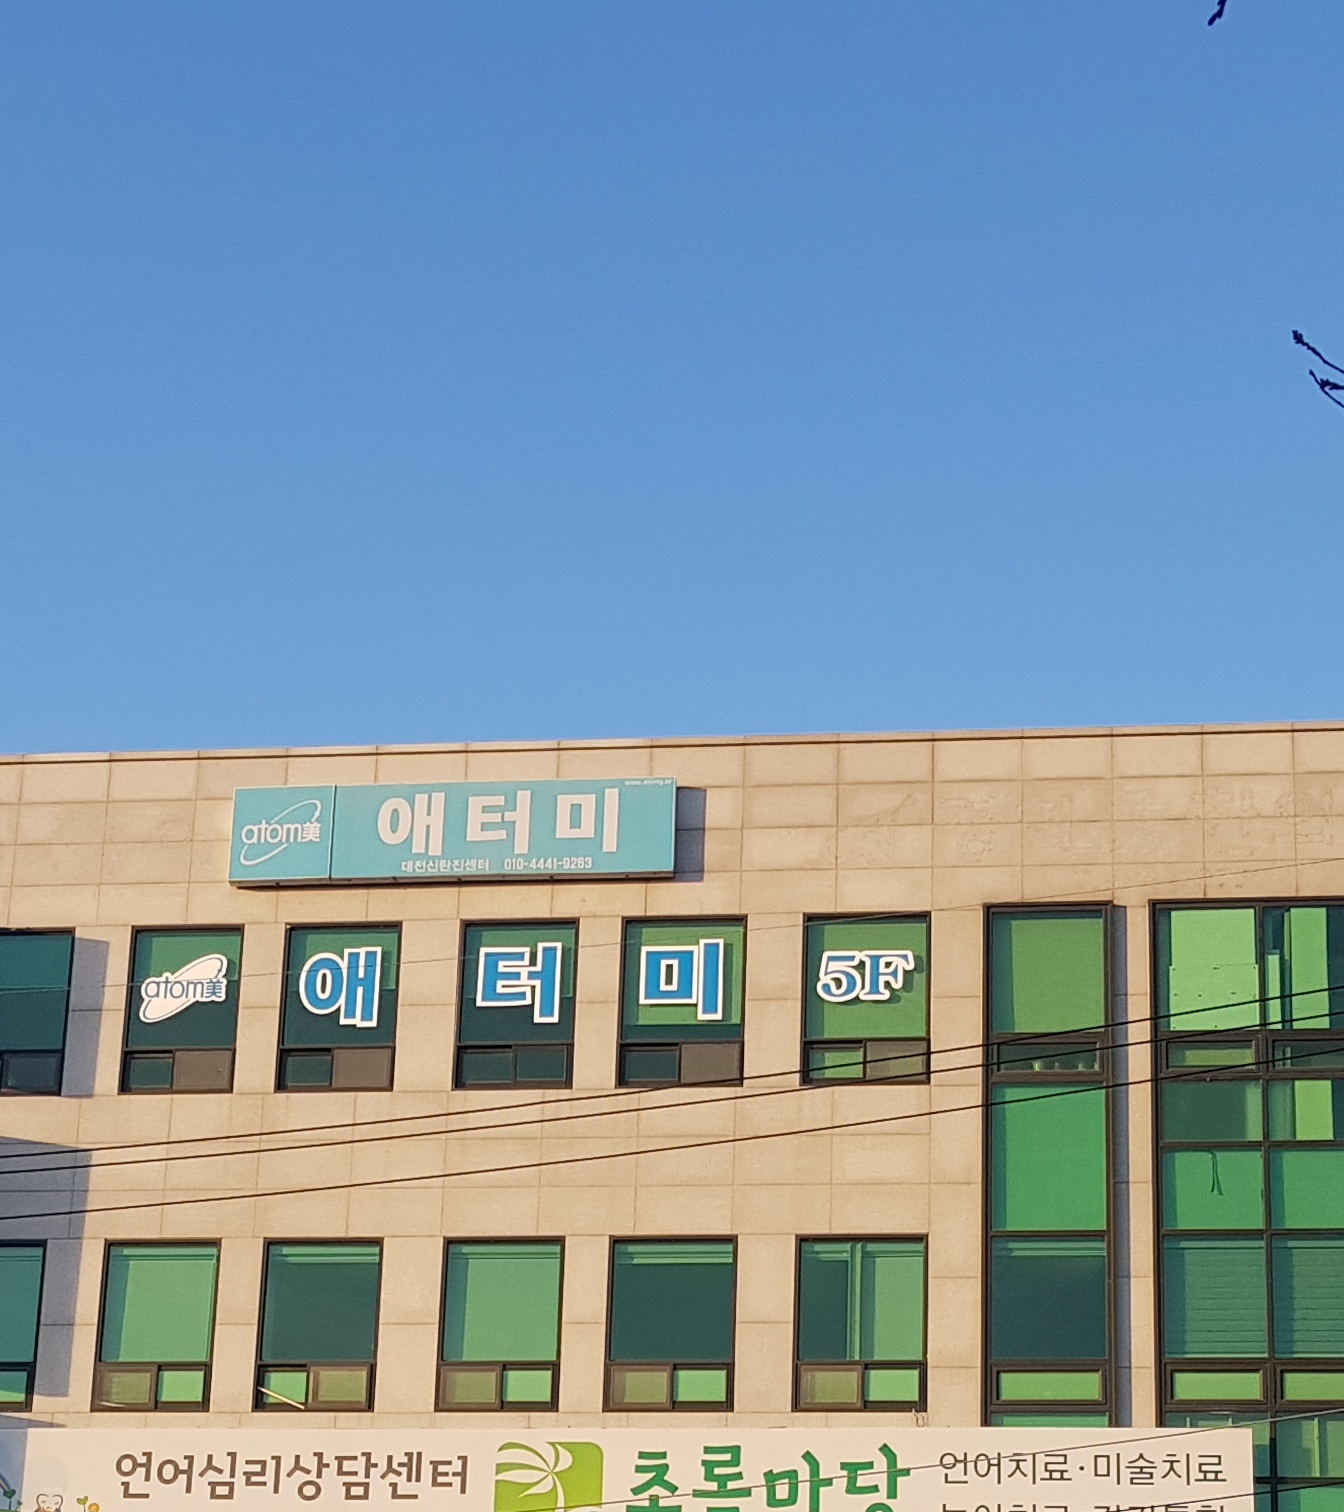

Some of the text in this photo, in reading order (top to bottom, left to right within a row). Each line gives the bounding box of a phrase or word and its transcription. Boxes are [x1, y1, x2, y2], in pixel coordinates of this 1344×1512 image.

[376, 786, 619, 856] 애터미
[401, 857, 490, 873] 대전신탄진센터
[816, 948, 916, 1004] 5F
[115, 1450, 469, 1502] 언어심리상담센터
